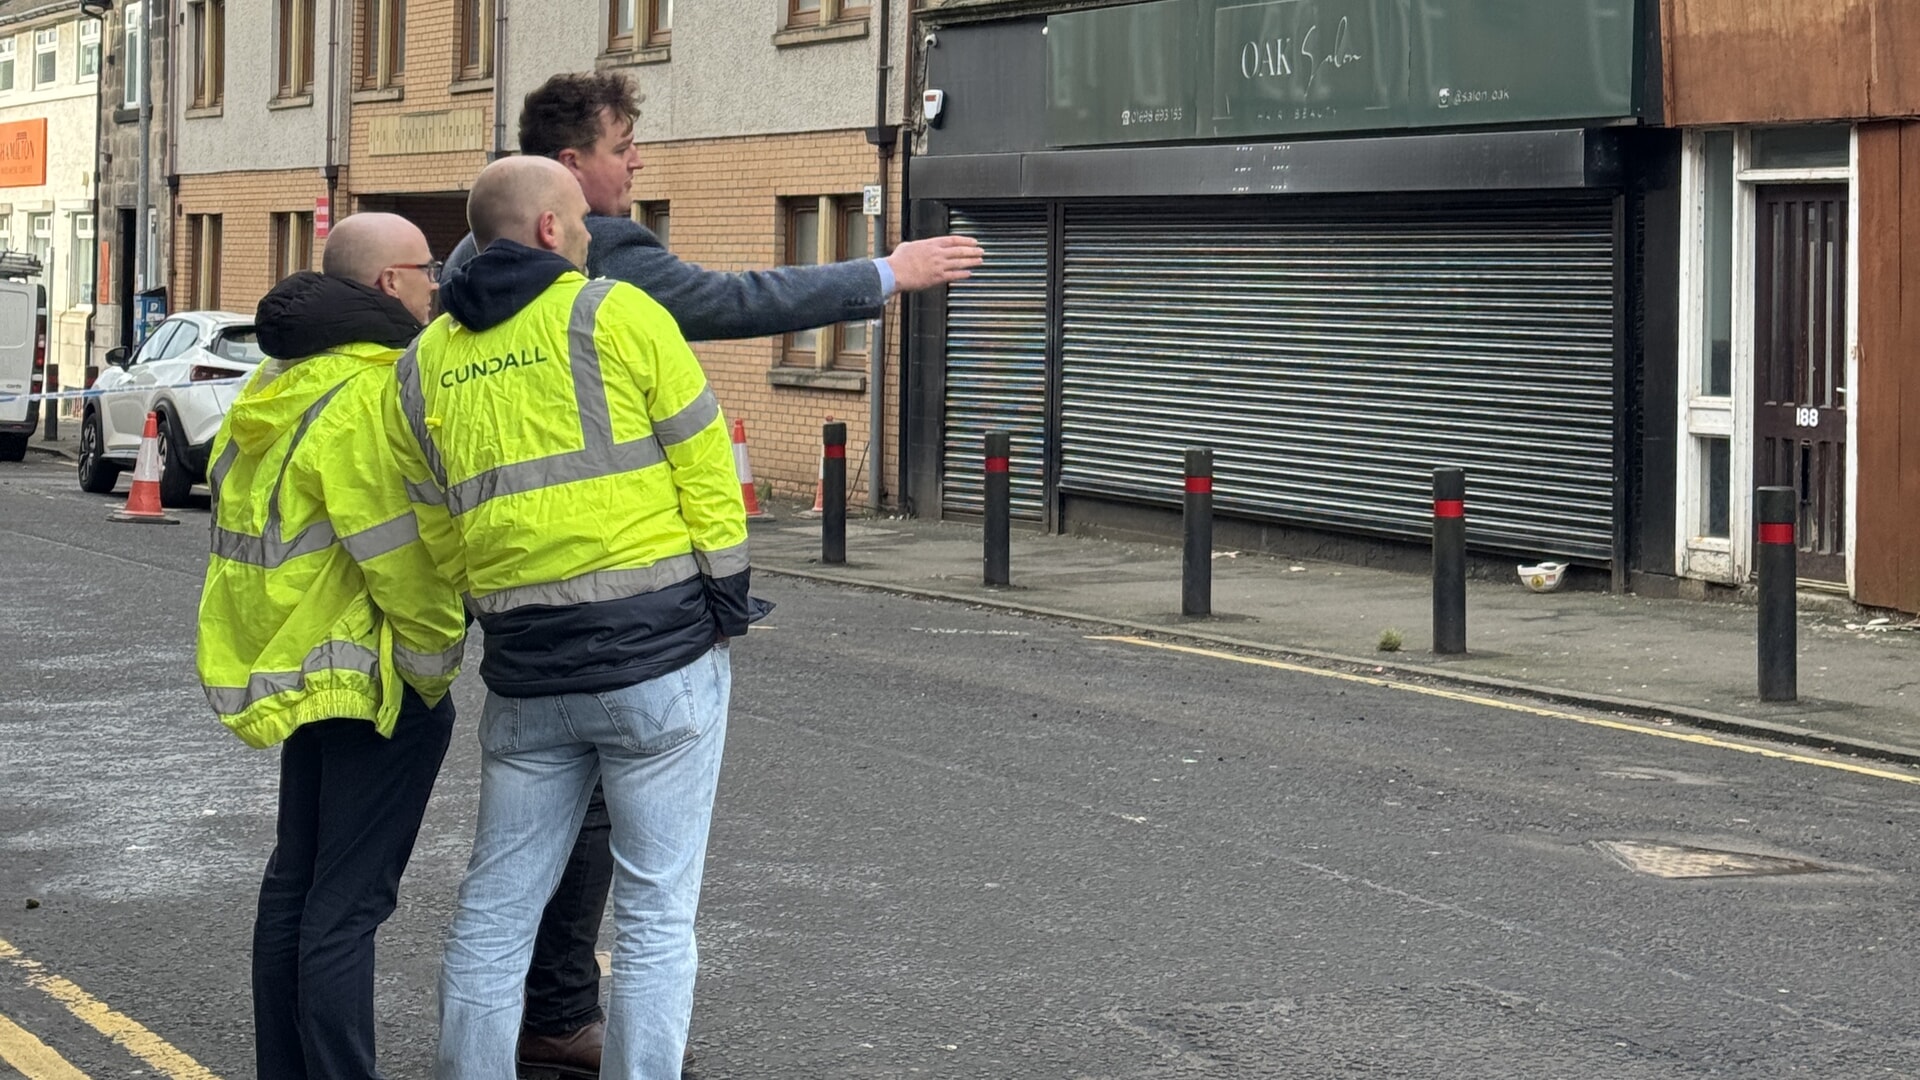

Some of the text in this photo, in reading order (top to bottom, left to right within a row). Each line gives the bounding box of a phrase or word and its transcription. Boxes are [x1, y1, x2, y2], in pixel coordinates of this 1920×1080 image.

[1241, 38, 1292, 79] OAK
[440, 346, 548, 389] CUNDALL
[1796, 407, 1819, 427] 188
